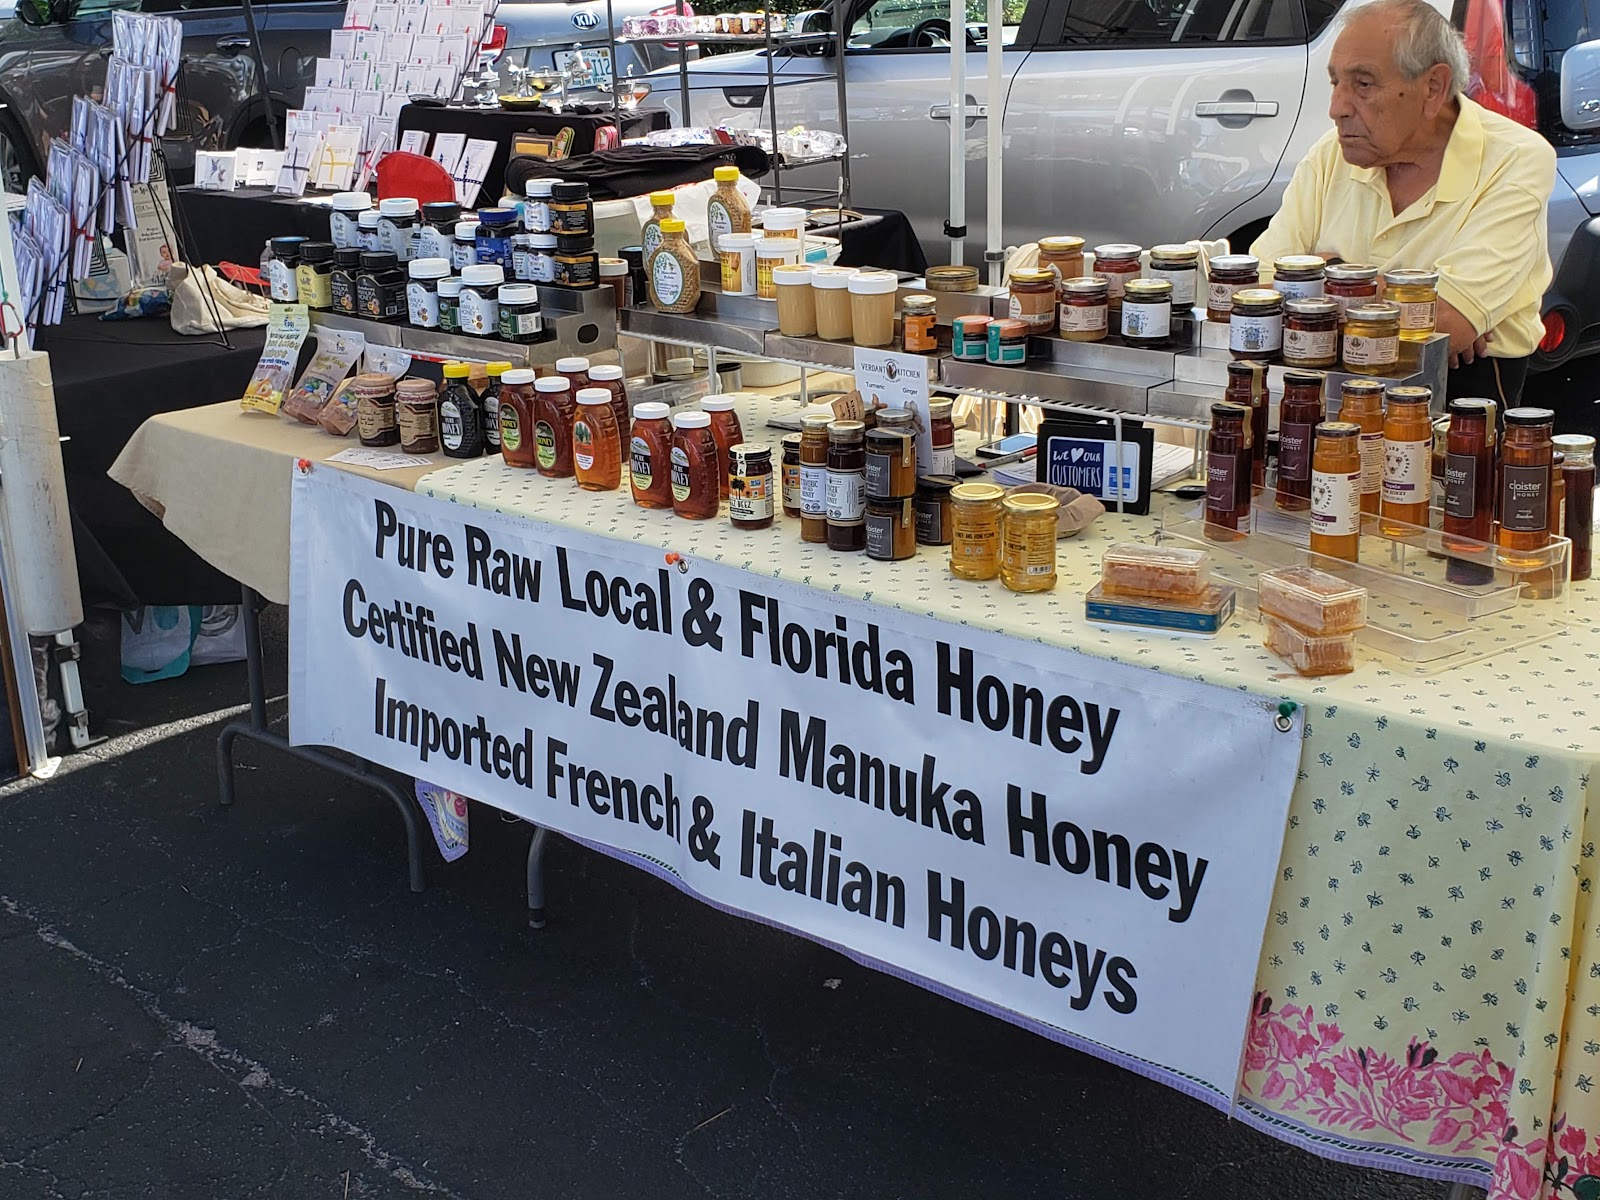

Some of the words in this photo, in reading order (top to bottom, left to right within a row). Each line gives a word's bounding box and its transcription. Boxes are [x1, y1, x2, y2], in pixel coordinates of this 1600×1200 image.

[575, 12, 599, 27] KIA
[861, 362, 886, 374] VERDANT
[897, 368, 921, 379] KITCHEN
[902, 387, 918, 396] Ginger
[634, 454, 645, 462] PURE
[631, 459, 651, 475] HONEY
[1051, 464, 1102, 488] CUSTOMERS
[1509, 480, 1542, 494] cloister
[375, 499, 454, 578] Pure
[465, 524, 541, 602] Raw
[556, 546, 672, 635] Local
[682, 577, 723, 652] &
[739, 589, 915, 705] Florida
[936, 641, 1120, 775] Honey
[343, 578, 484, 681] Certified
[492, 629, 581, 708] New
[590, 653, 759, 769] Zealand
[779, 709, 985, 846] Manuka
[1007, 783, 1209, 923] Honey
[375, 678, 533, 790] Imported
[547, 736, 680, 845] French
[688, 796, 721, 870] &
[740, 809, 905, 929] Italian
[927, 869, 1138, 1014] Honeys
